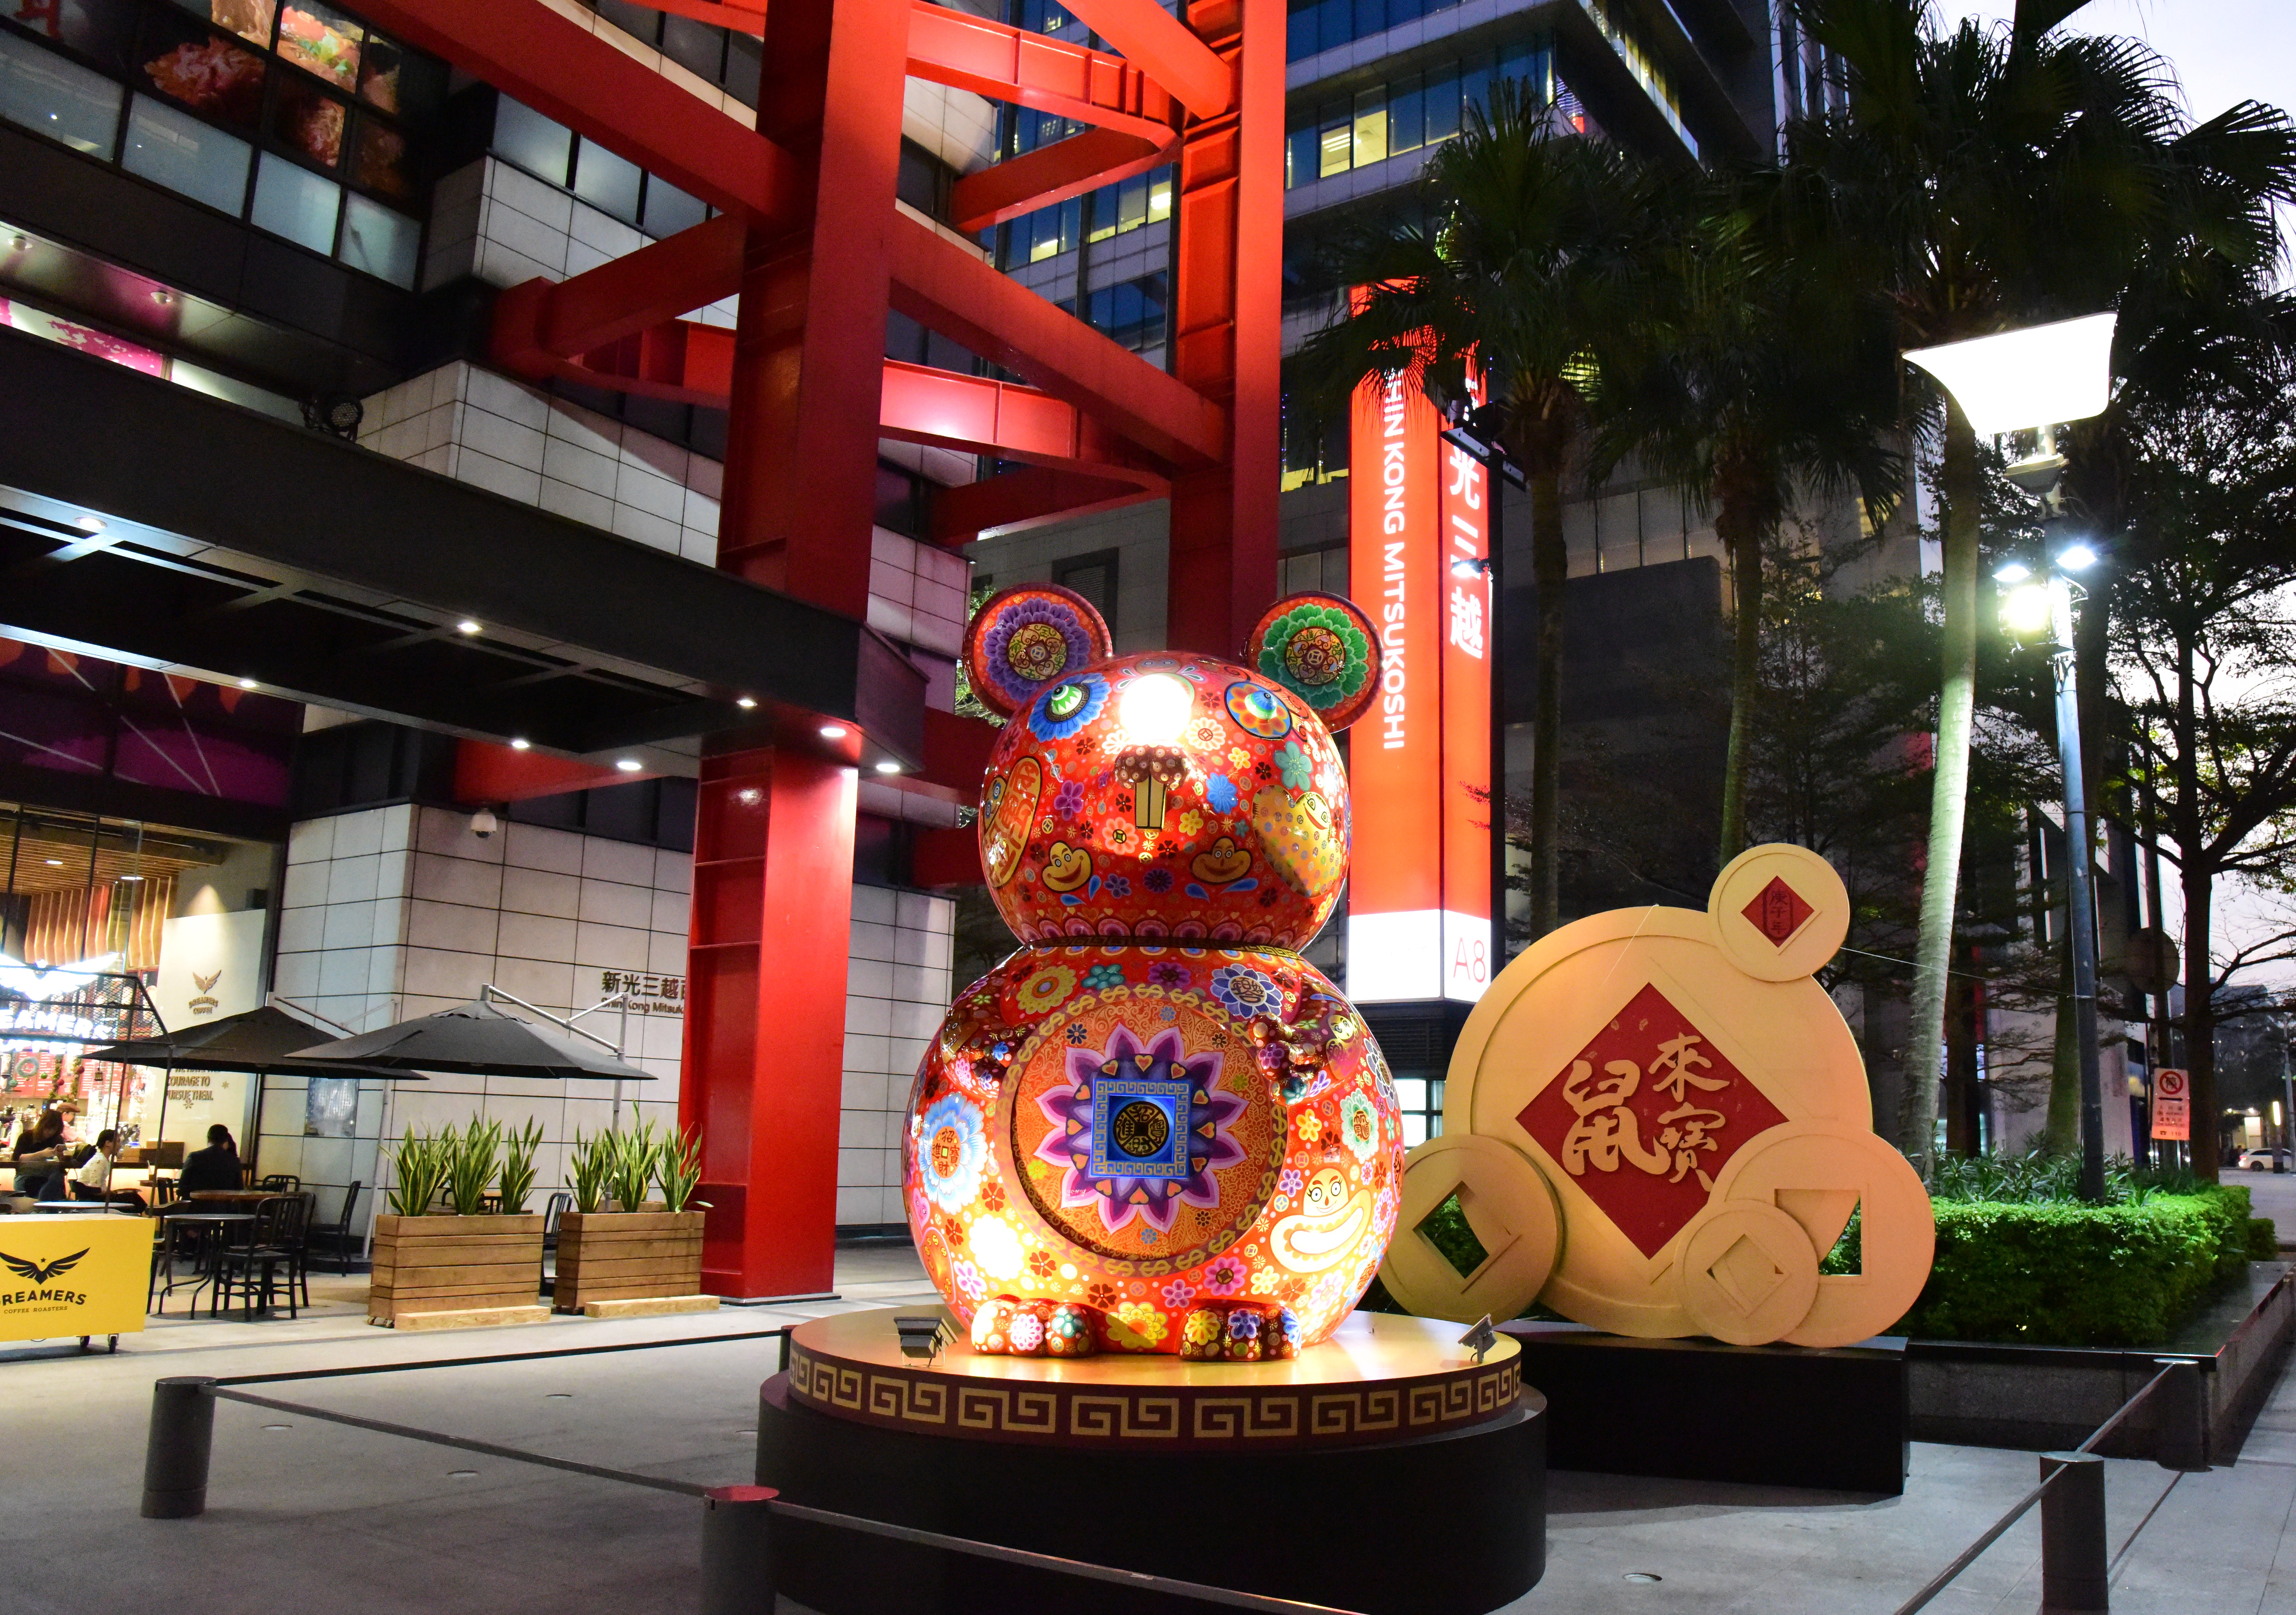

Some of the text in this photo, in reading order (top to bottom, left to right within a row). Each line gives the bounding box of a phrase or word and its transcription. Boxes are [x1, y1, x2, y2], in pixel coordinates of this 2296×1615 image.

[1449, 378, 1483, 659] 光三越
[1384, 368, 1405, 748] HIN KONG MITSUKOSHI
[1453, 937, 1485, 983] A8
[652, 1002, 683, 1014] Mitsuk
[200, 1076, 210, 1086] TO
[167, 1090, 191, 1101] URSUE
[0, 1290, 87, 1306] REAMERS
